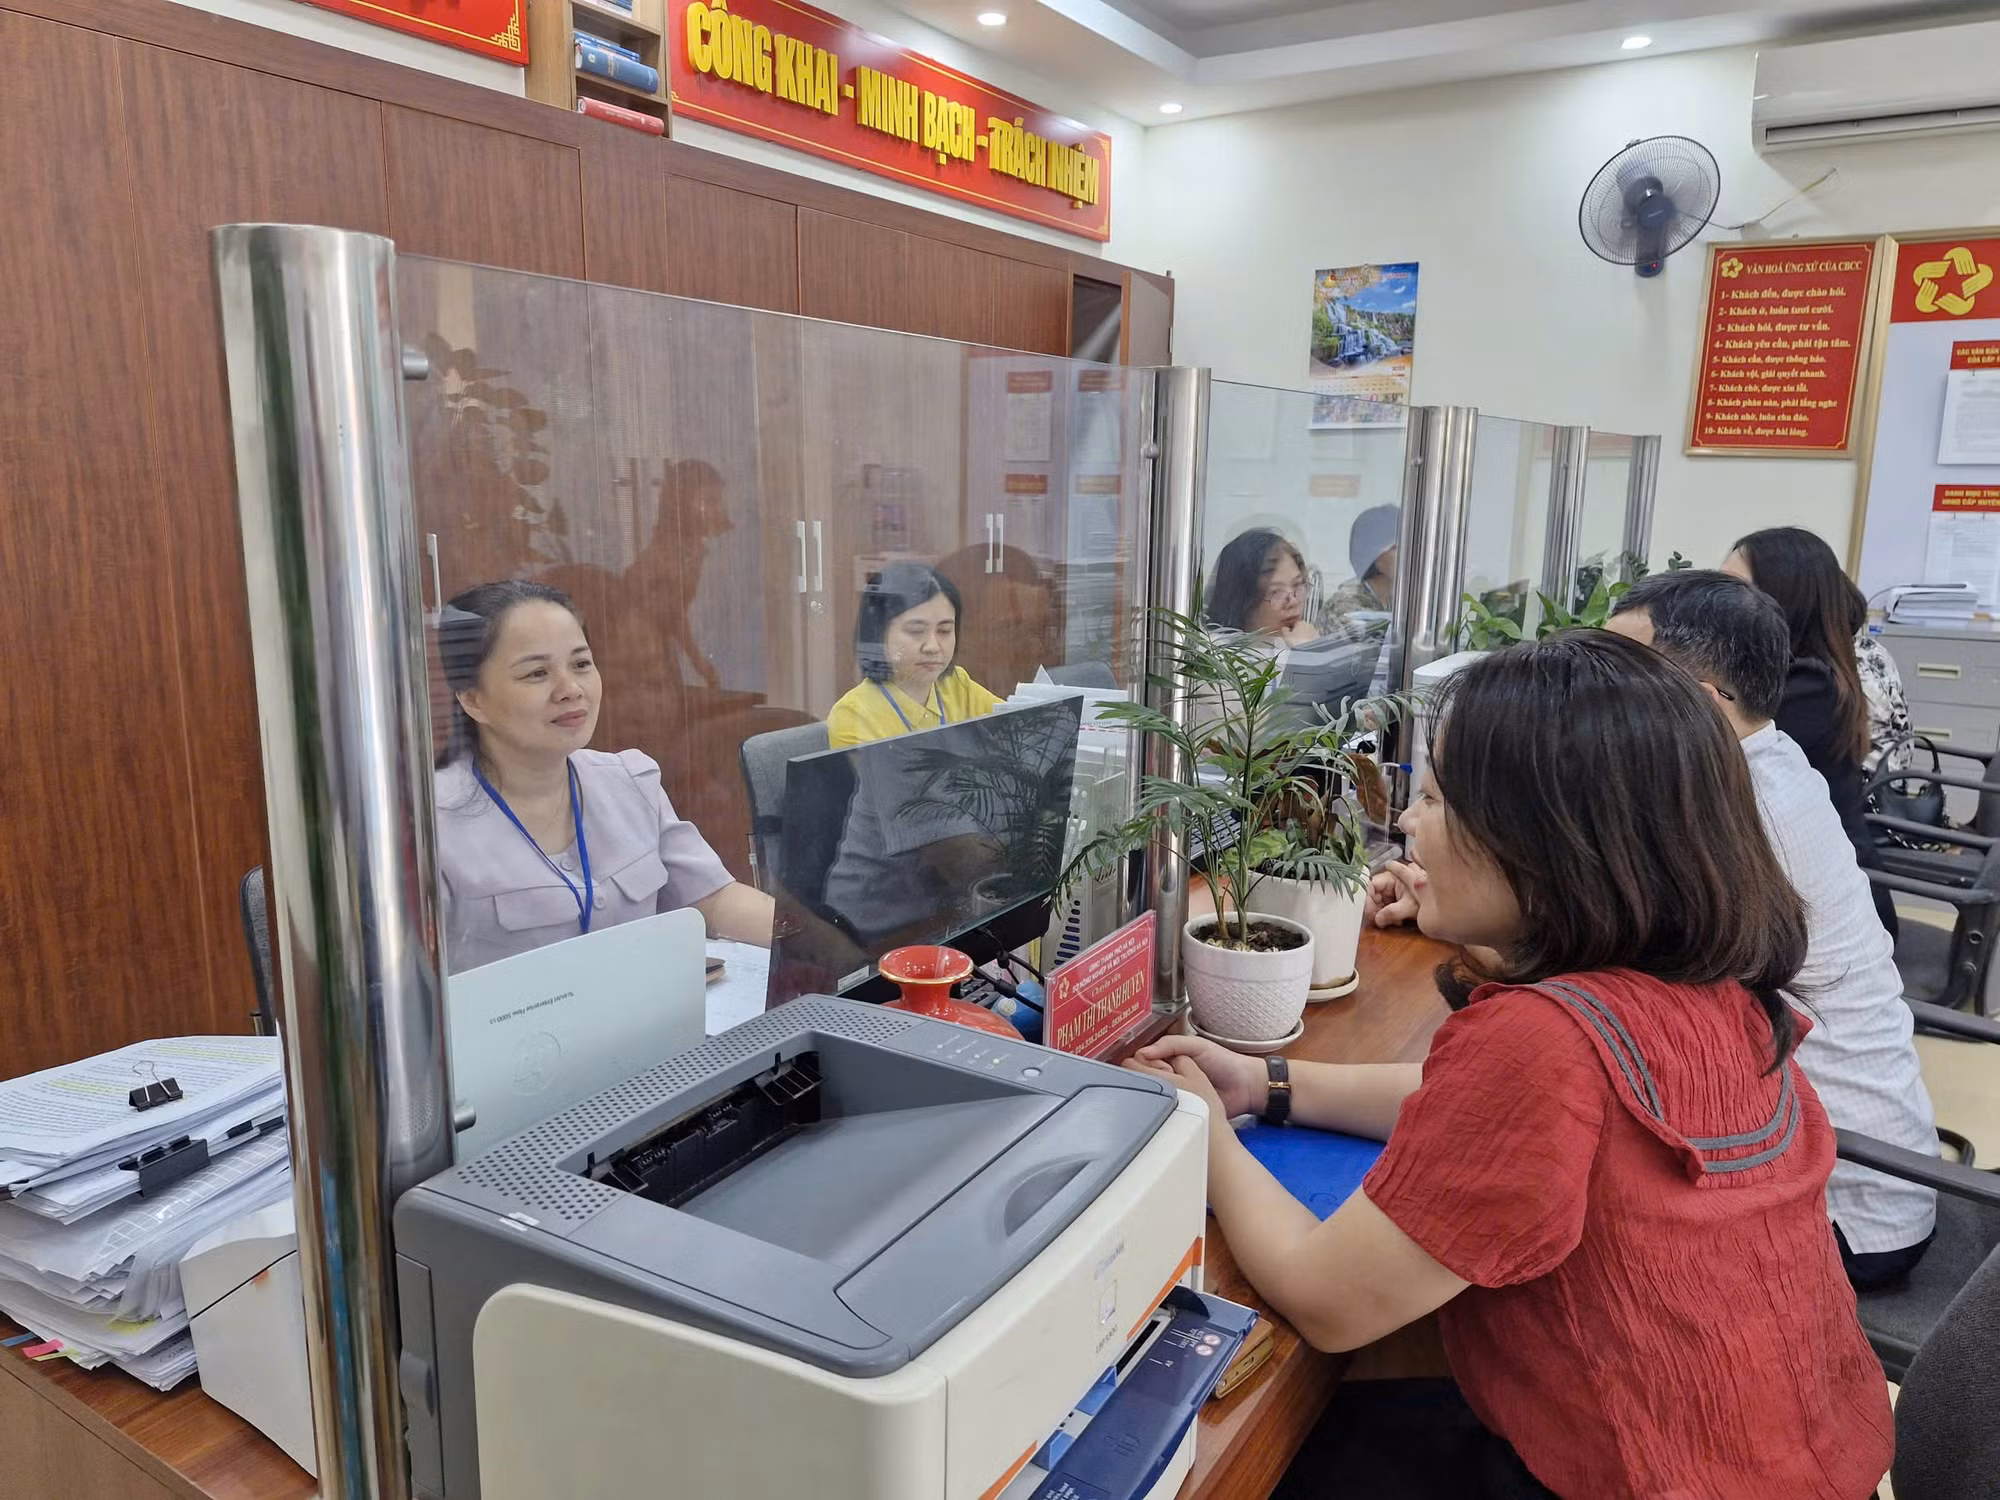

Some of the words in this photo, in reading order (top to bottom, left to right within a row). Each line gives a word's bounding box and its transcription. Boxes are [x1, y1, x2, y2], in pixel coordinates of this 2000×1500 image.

[687, 0, 772, 93] CÔNG
[775, 34, 838, 115] KHAI
[856, 65, 919, 142] MINH
[920, 90, 975, 165] BẠCH
[988, 117, 1047, 187] TRÁCH
[1047, 141, 1099, 209] NHIỆM
[1747, 264, 1764, 274] VĂN
[1785, 262, 1804, 273] ỨNG
[1804, 261, 1818, 272] XỬ
[1820, 260, 1838, 272] CỦA
[1838, 261, 1862, 271] CBCC
[1721, 291, 1729, 299] 1-
[1731, 289, 1759, 299] Khách
[1761, 288, 1779, 298] đến,
[1782, 289, 1804, 298] được
[1806, 288, 1827, 296] chào
[1829, 288, 1846, 296] hỏi.
[1718, 307, 1726, 315] 2-
[1729, 306, 1757, 315] Khách
[1770, 306, 1789, 314] luôn
[1791, 305, 1810, 314] tươi
[1812, 304, 1834, 313] cười.
[1727, 323, 1755, 332] Khách
[1757, 322, 1773, 332] hỏi,
[1776, 323, 1797, 332] được
[1812, 320, 1830, 330] vấn.
[1725, 339, 1753, 348] Khách
[1754, 340, 1770, 350] yêu
[1772, 338, 1790, 348] cầu,
[1792, 338, 1812, 349] phải
[1814, 338, 1829, 349] tận
[1831, 338, 1851, 347] tâm.
[1765, 355, 1784, 364] được
[1786, 355, 1808, 364] thông
[1761, 370, 1775, 378] giải
[1777, 368, 1798, 378] quyết
[1762, 384, 1781, 392] được
[1781, 398, 1798, 408] phải
[1755, 427, 1775, 436] được
[1057, 1014, 1081, 1050] PHẠM
[1083, 1004, 1095, 1032] THỊ
[1096, 986, 1121, 1022] THANH
